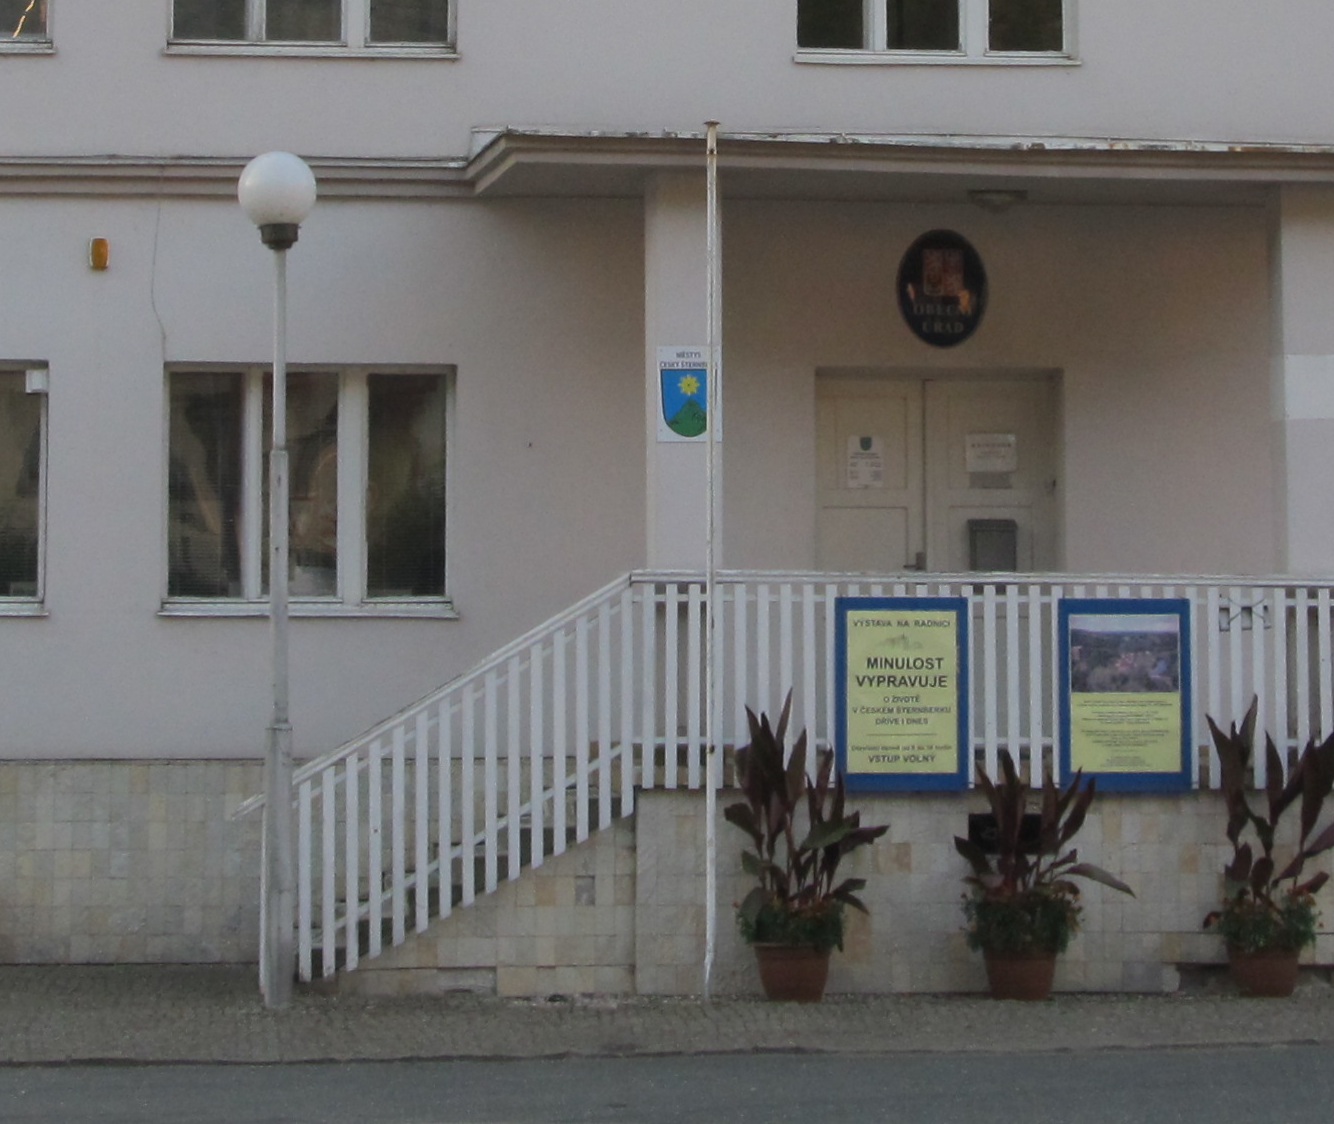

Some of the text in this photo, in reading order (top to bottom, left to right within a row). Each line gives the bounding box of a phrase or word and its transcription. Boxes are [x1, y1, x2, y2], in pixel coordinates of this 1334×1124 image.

[853, 617, 951, 627] VÝSTAVA NA RADNICI
[866, 657, 945, 670] MINULOST
[856, 675, 948, 688] VYPRAVUJE
[883, 694, 921, 703] O ŽIVOTĚ
[859, 705, 894, 714] ČESKÉM
[875, 715, 899, 725] DŘÍVE
[906, 717, 929, 725] DNES
[868, 754, 936, 764] VSTUP VOLNÝ
